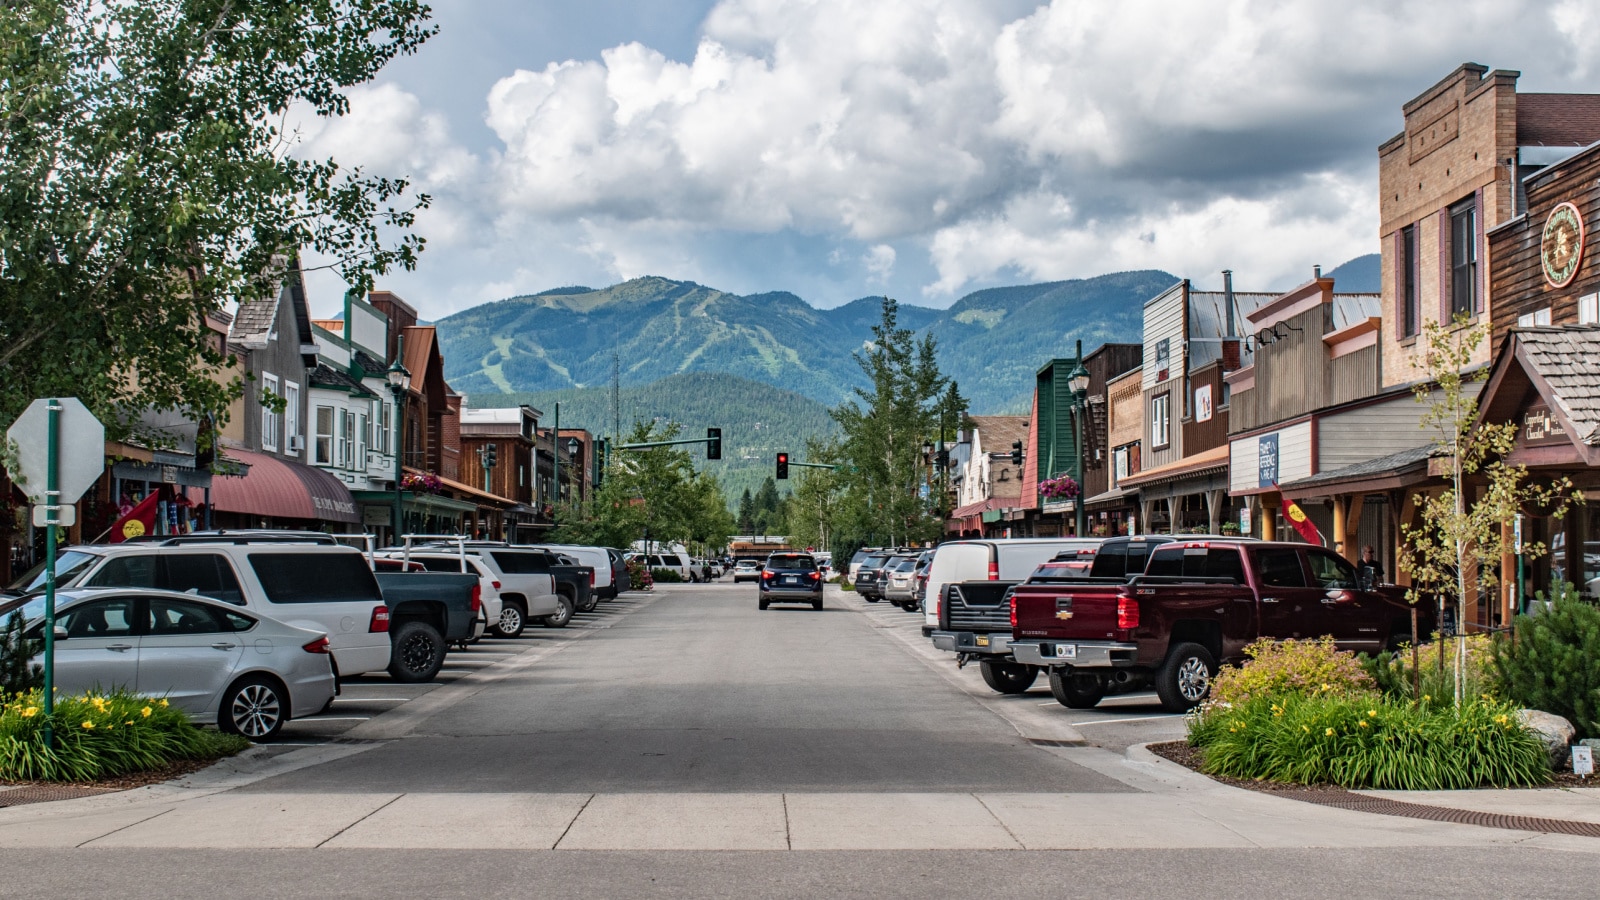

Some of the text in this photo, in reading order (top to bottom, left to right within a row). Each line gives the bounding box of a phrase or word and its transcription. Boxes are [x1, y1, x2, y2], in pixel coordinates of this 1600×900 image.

[1545, 207, 1567, 239] Central
[1544, 250, 1562, 282] Bakery
[1525, 410, 1545, 428] Copperleaf
[1526, 427, 1545, 440] Chocolat
